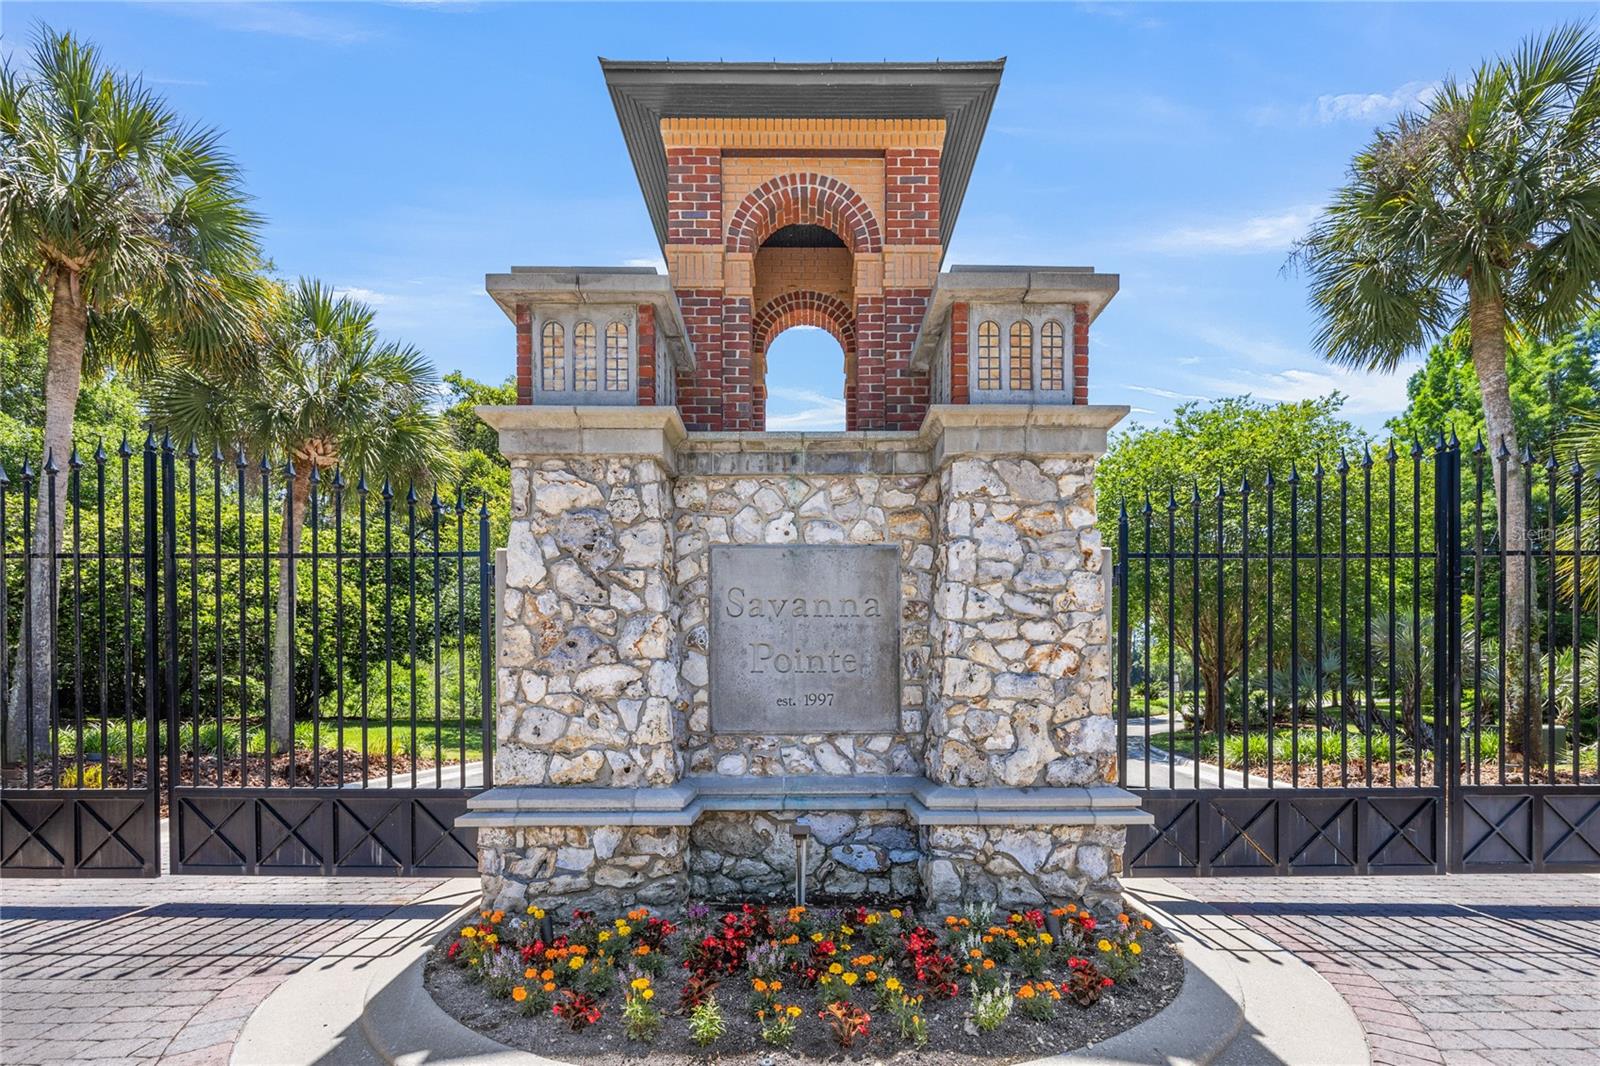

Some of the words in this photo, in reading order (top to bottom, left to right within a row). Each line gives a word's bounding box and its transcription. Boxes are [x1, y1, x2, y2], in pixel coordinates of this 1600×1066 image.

[726, 586, 881, 618] Savanna
[748, 642, 857, 674] Pointe
[776, 697, 797, 707] est.
[804, 692, 835, 707] 1997
